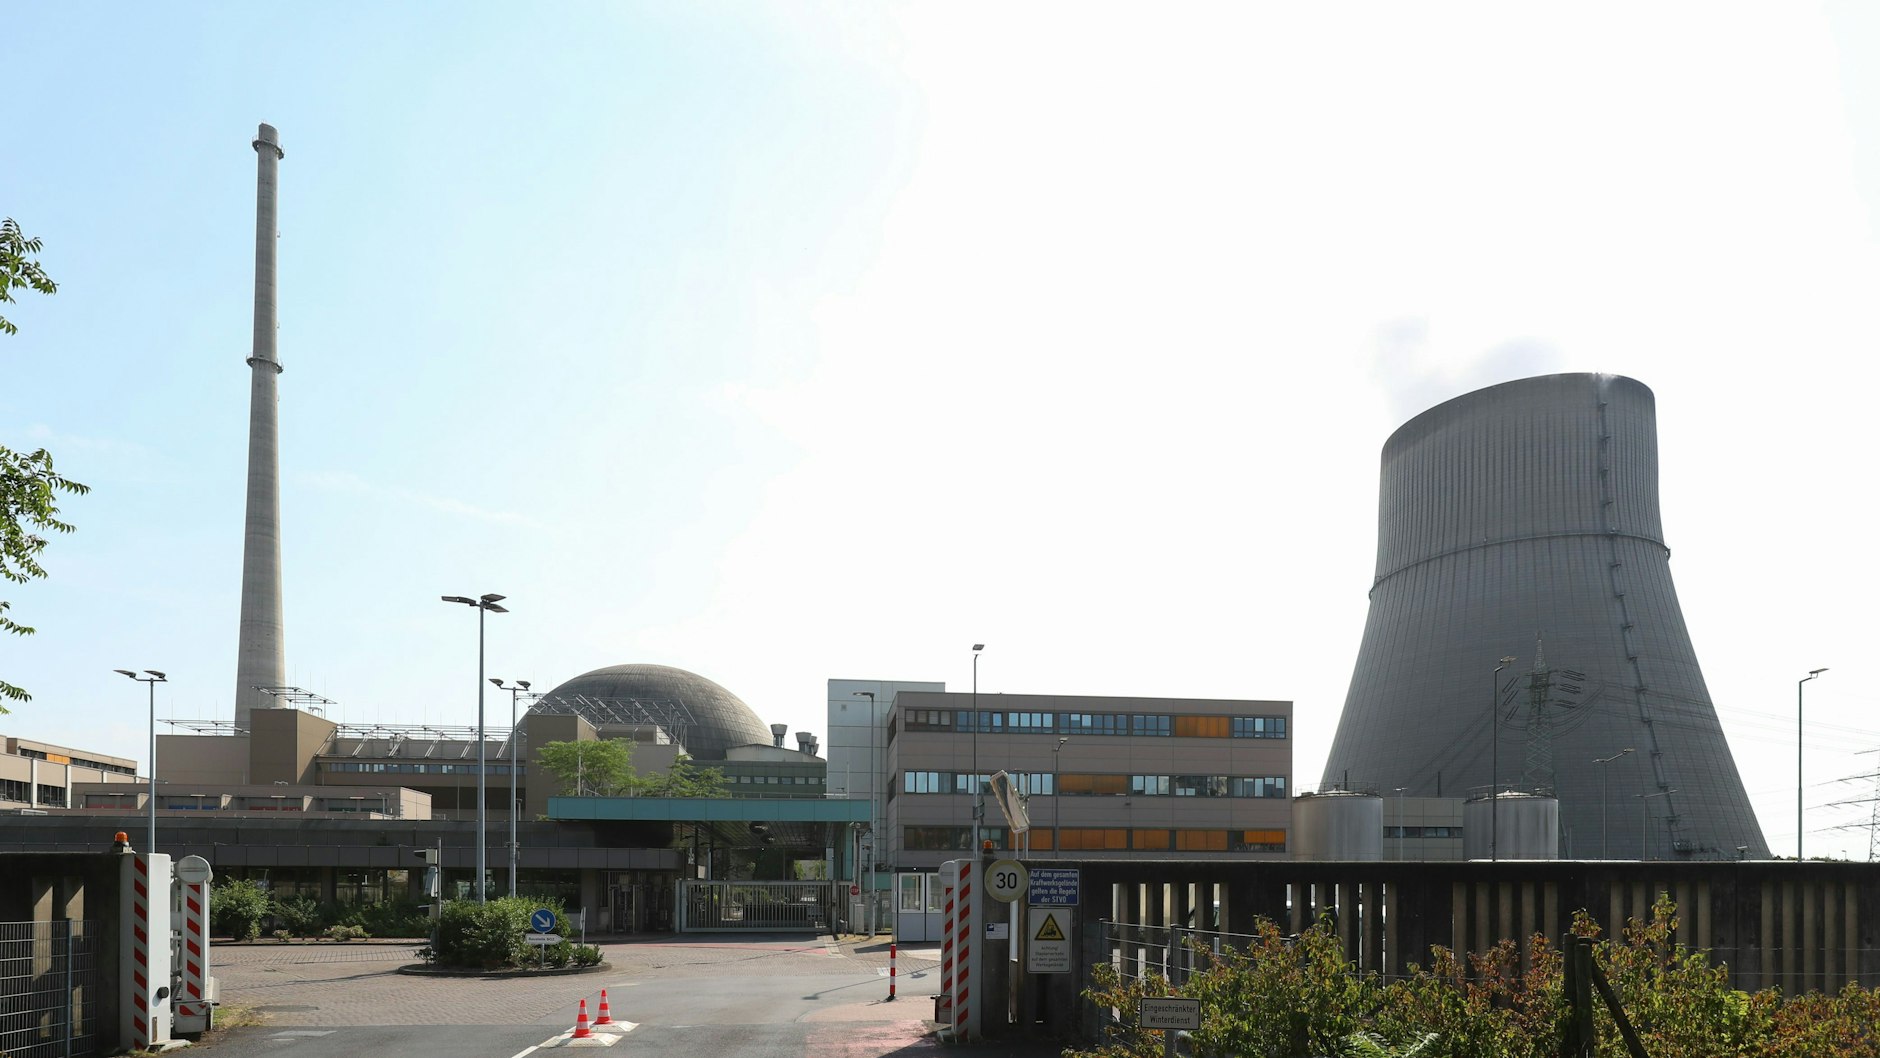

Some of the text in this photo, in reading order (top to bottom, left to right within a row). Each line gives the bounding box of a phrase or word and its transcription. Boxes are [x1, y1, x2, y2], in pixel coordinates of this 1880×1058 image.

[1031, 870, 1078, 879] Auf dem gesamten
[996, 872, 1017, 889] 30
[1030, 879, 1078, 888] Kraftwerksgelände
[1031, 887, 1077, 896] gelten die Regeln
[1144, 1003, 1197, 1014] Eingeschränkter
[1150, 1015, 1191, 1025] Winterdienst
